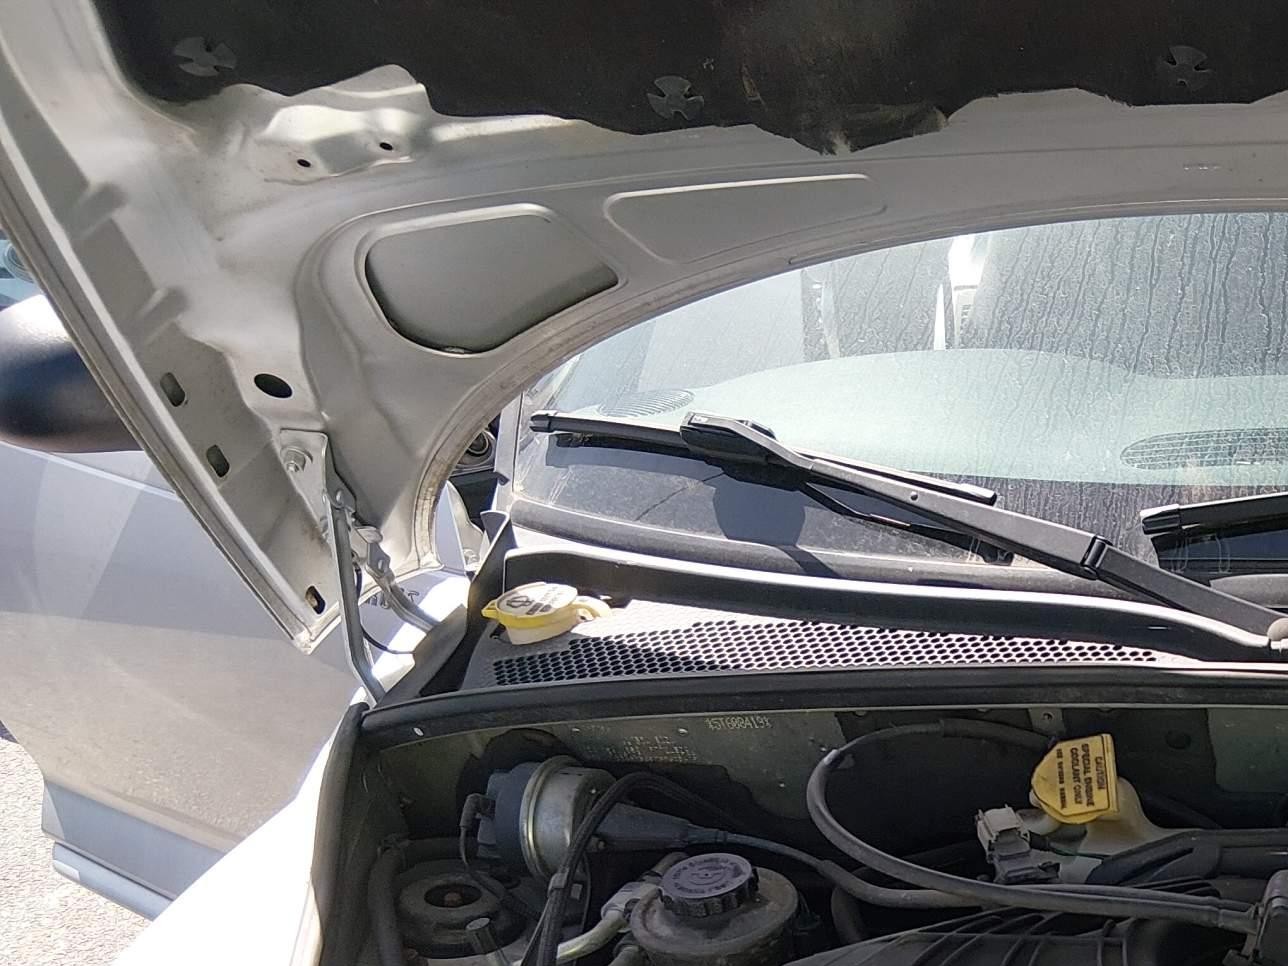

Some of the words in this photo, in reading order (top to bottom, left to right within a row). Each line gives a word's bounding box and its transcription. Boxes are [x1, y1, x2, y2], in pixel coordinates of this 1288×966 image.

[1070, 747, 1081, 783] COOLANT
[1081, 743, 1091, 776] SPECIAL
[1095, 757, 1105, 790] CAUTION
[1073, 784, 1082, 805] ONLY
[1085, 777, 1095, 807] ENGINE
